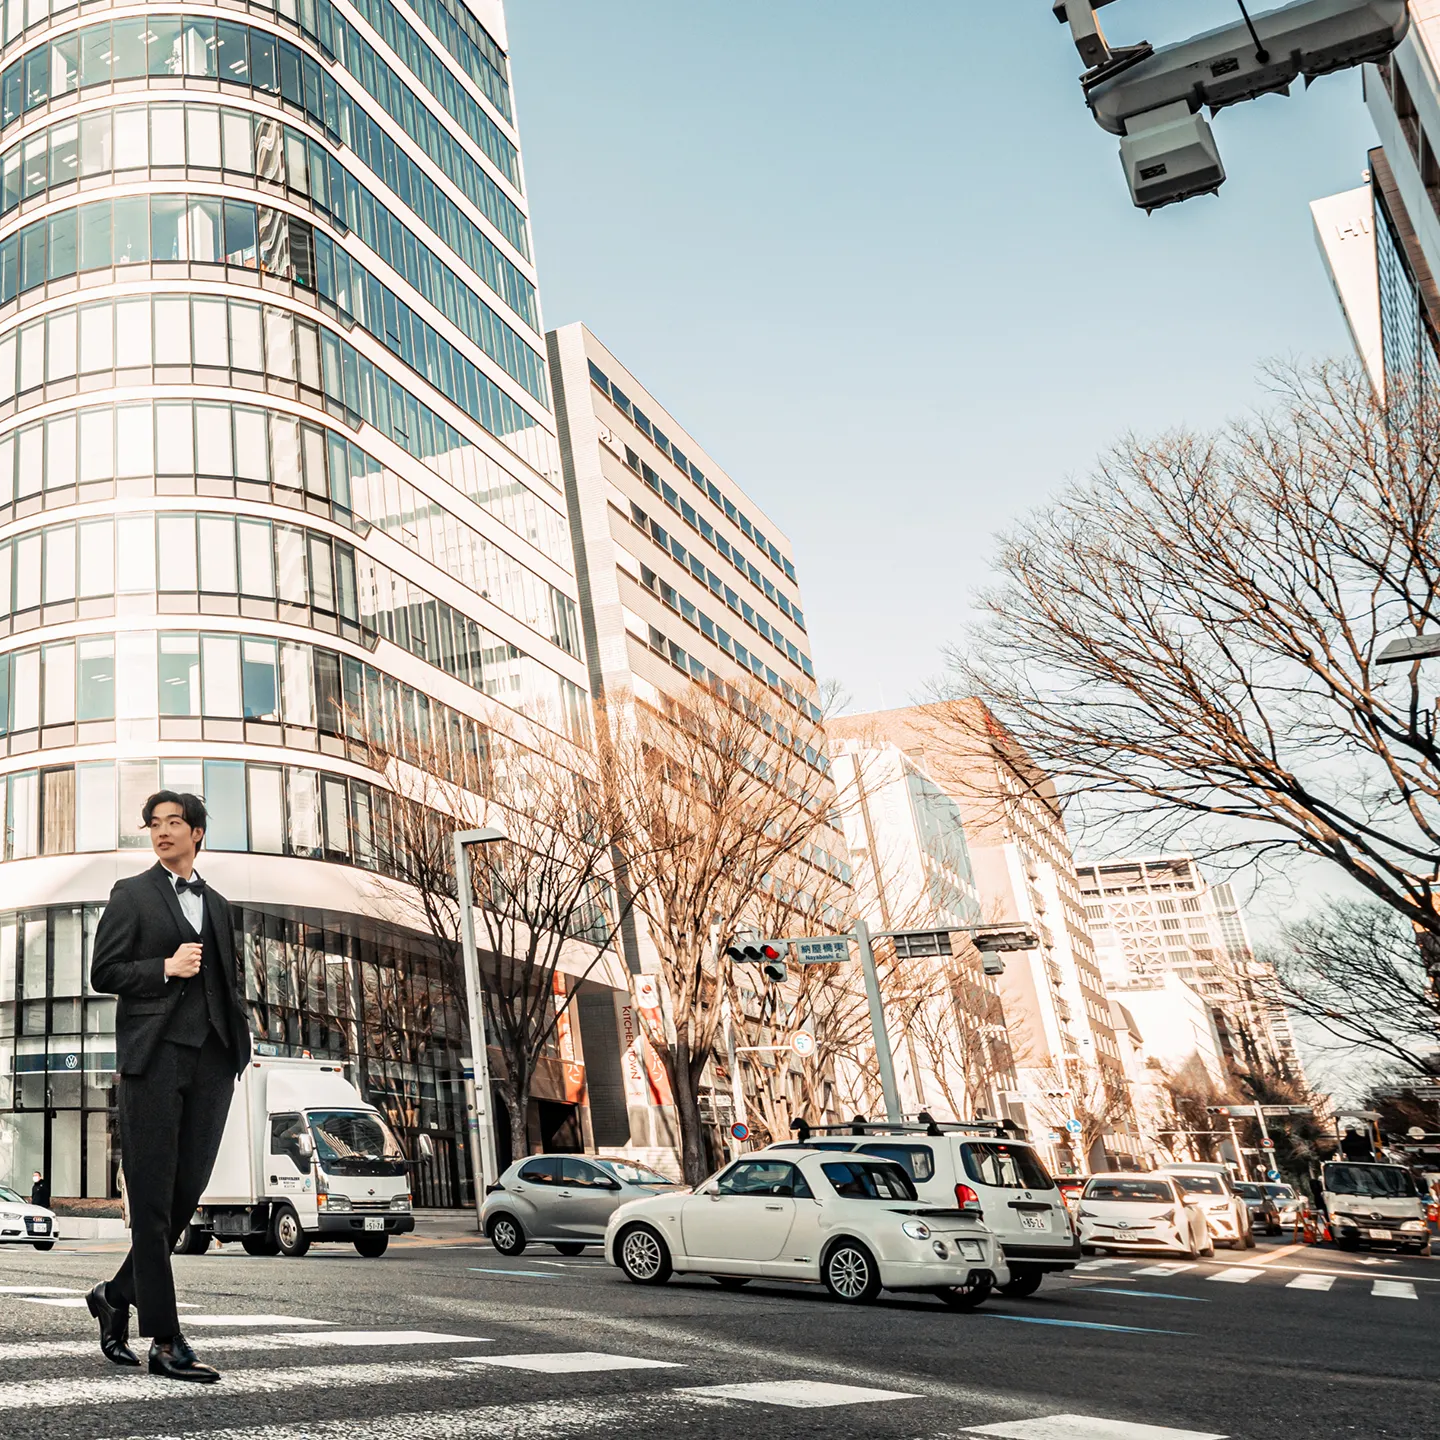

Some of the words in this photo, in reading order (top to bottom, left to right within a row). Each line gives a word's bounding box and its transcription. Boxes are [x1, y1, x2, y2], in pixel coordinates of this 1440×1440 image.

[1334, 216, 1369, 240] HI
[801, 943, 845, 954] 納屋橋東
[622, 1005, 634, 1048] KITCHEN
[628, 1050, 641, 1080] TOWN
